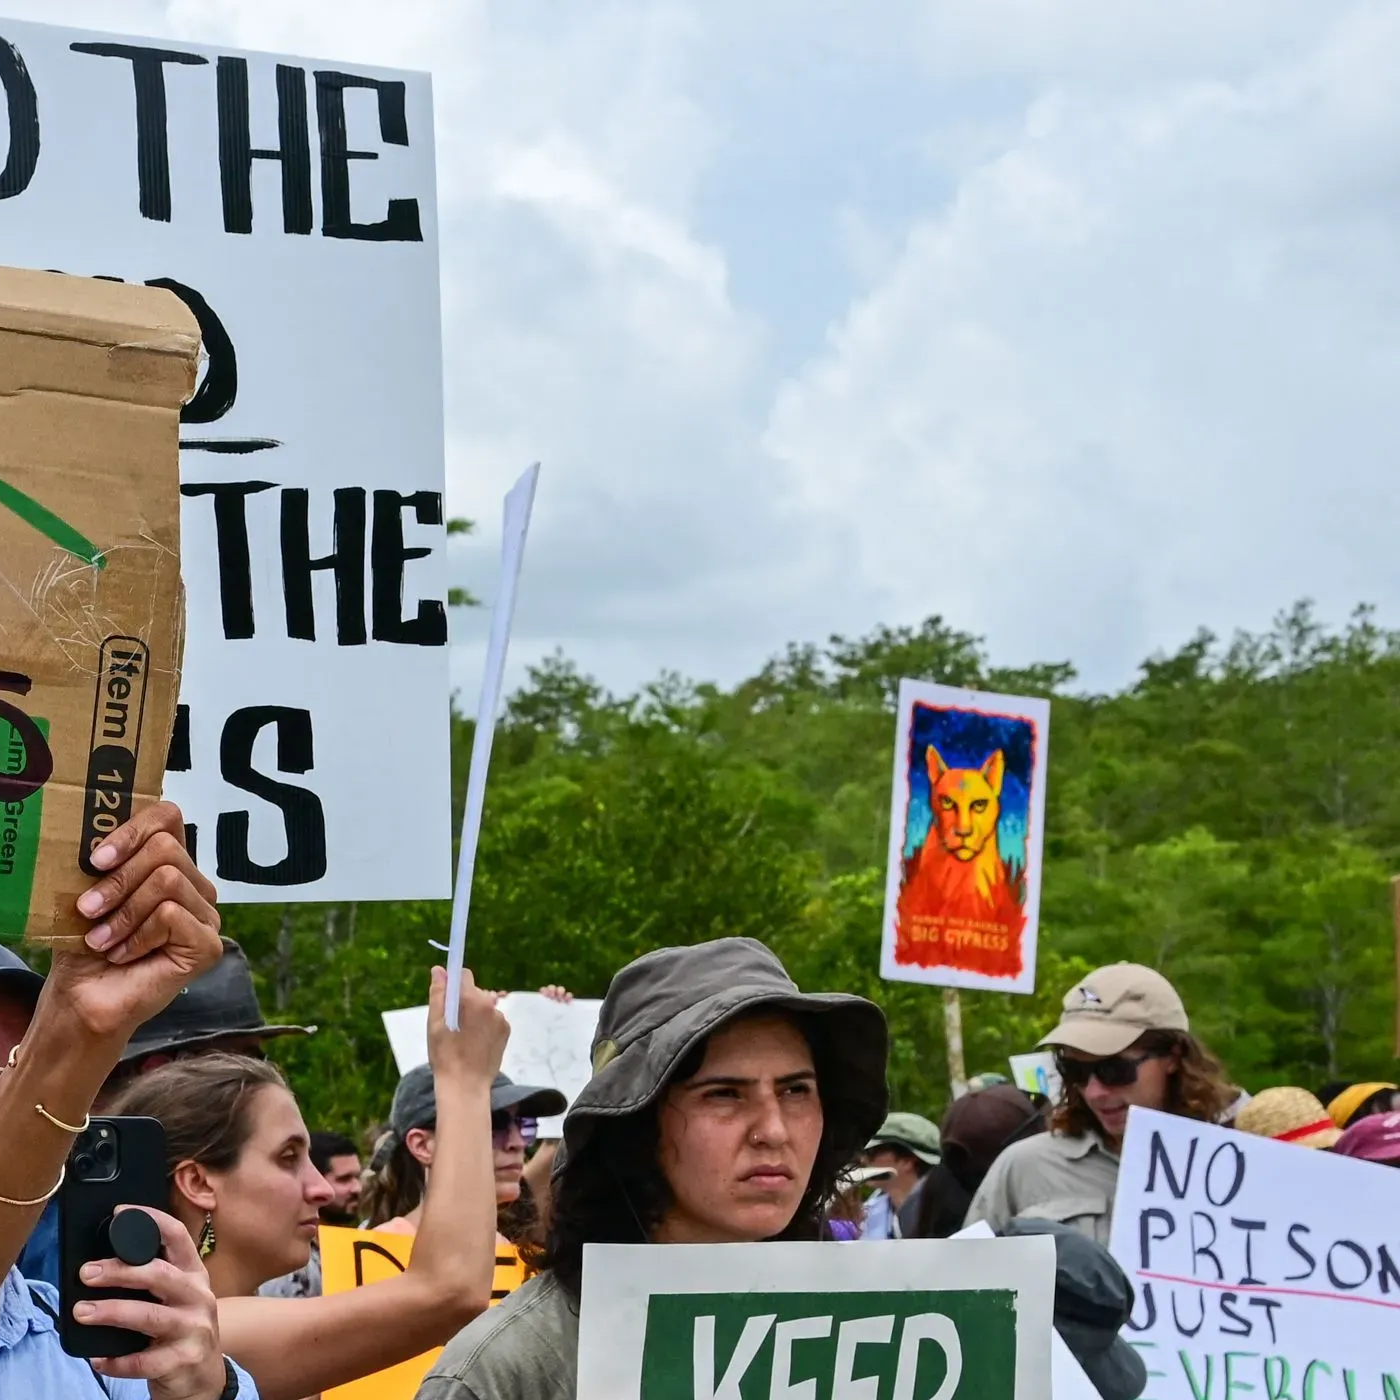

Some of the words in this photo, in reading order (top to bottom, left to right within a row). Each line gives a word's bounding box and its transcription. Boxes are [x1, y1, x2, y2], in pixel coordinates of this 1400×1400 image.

[69, 41, 424, 242] THE
[180, 481, 448, 645] THE
[102, 650, 143, 738] Item
[1144, 1130, 1246, 1207] NO
[1125, 1281, 1283, 1345] JUST
